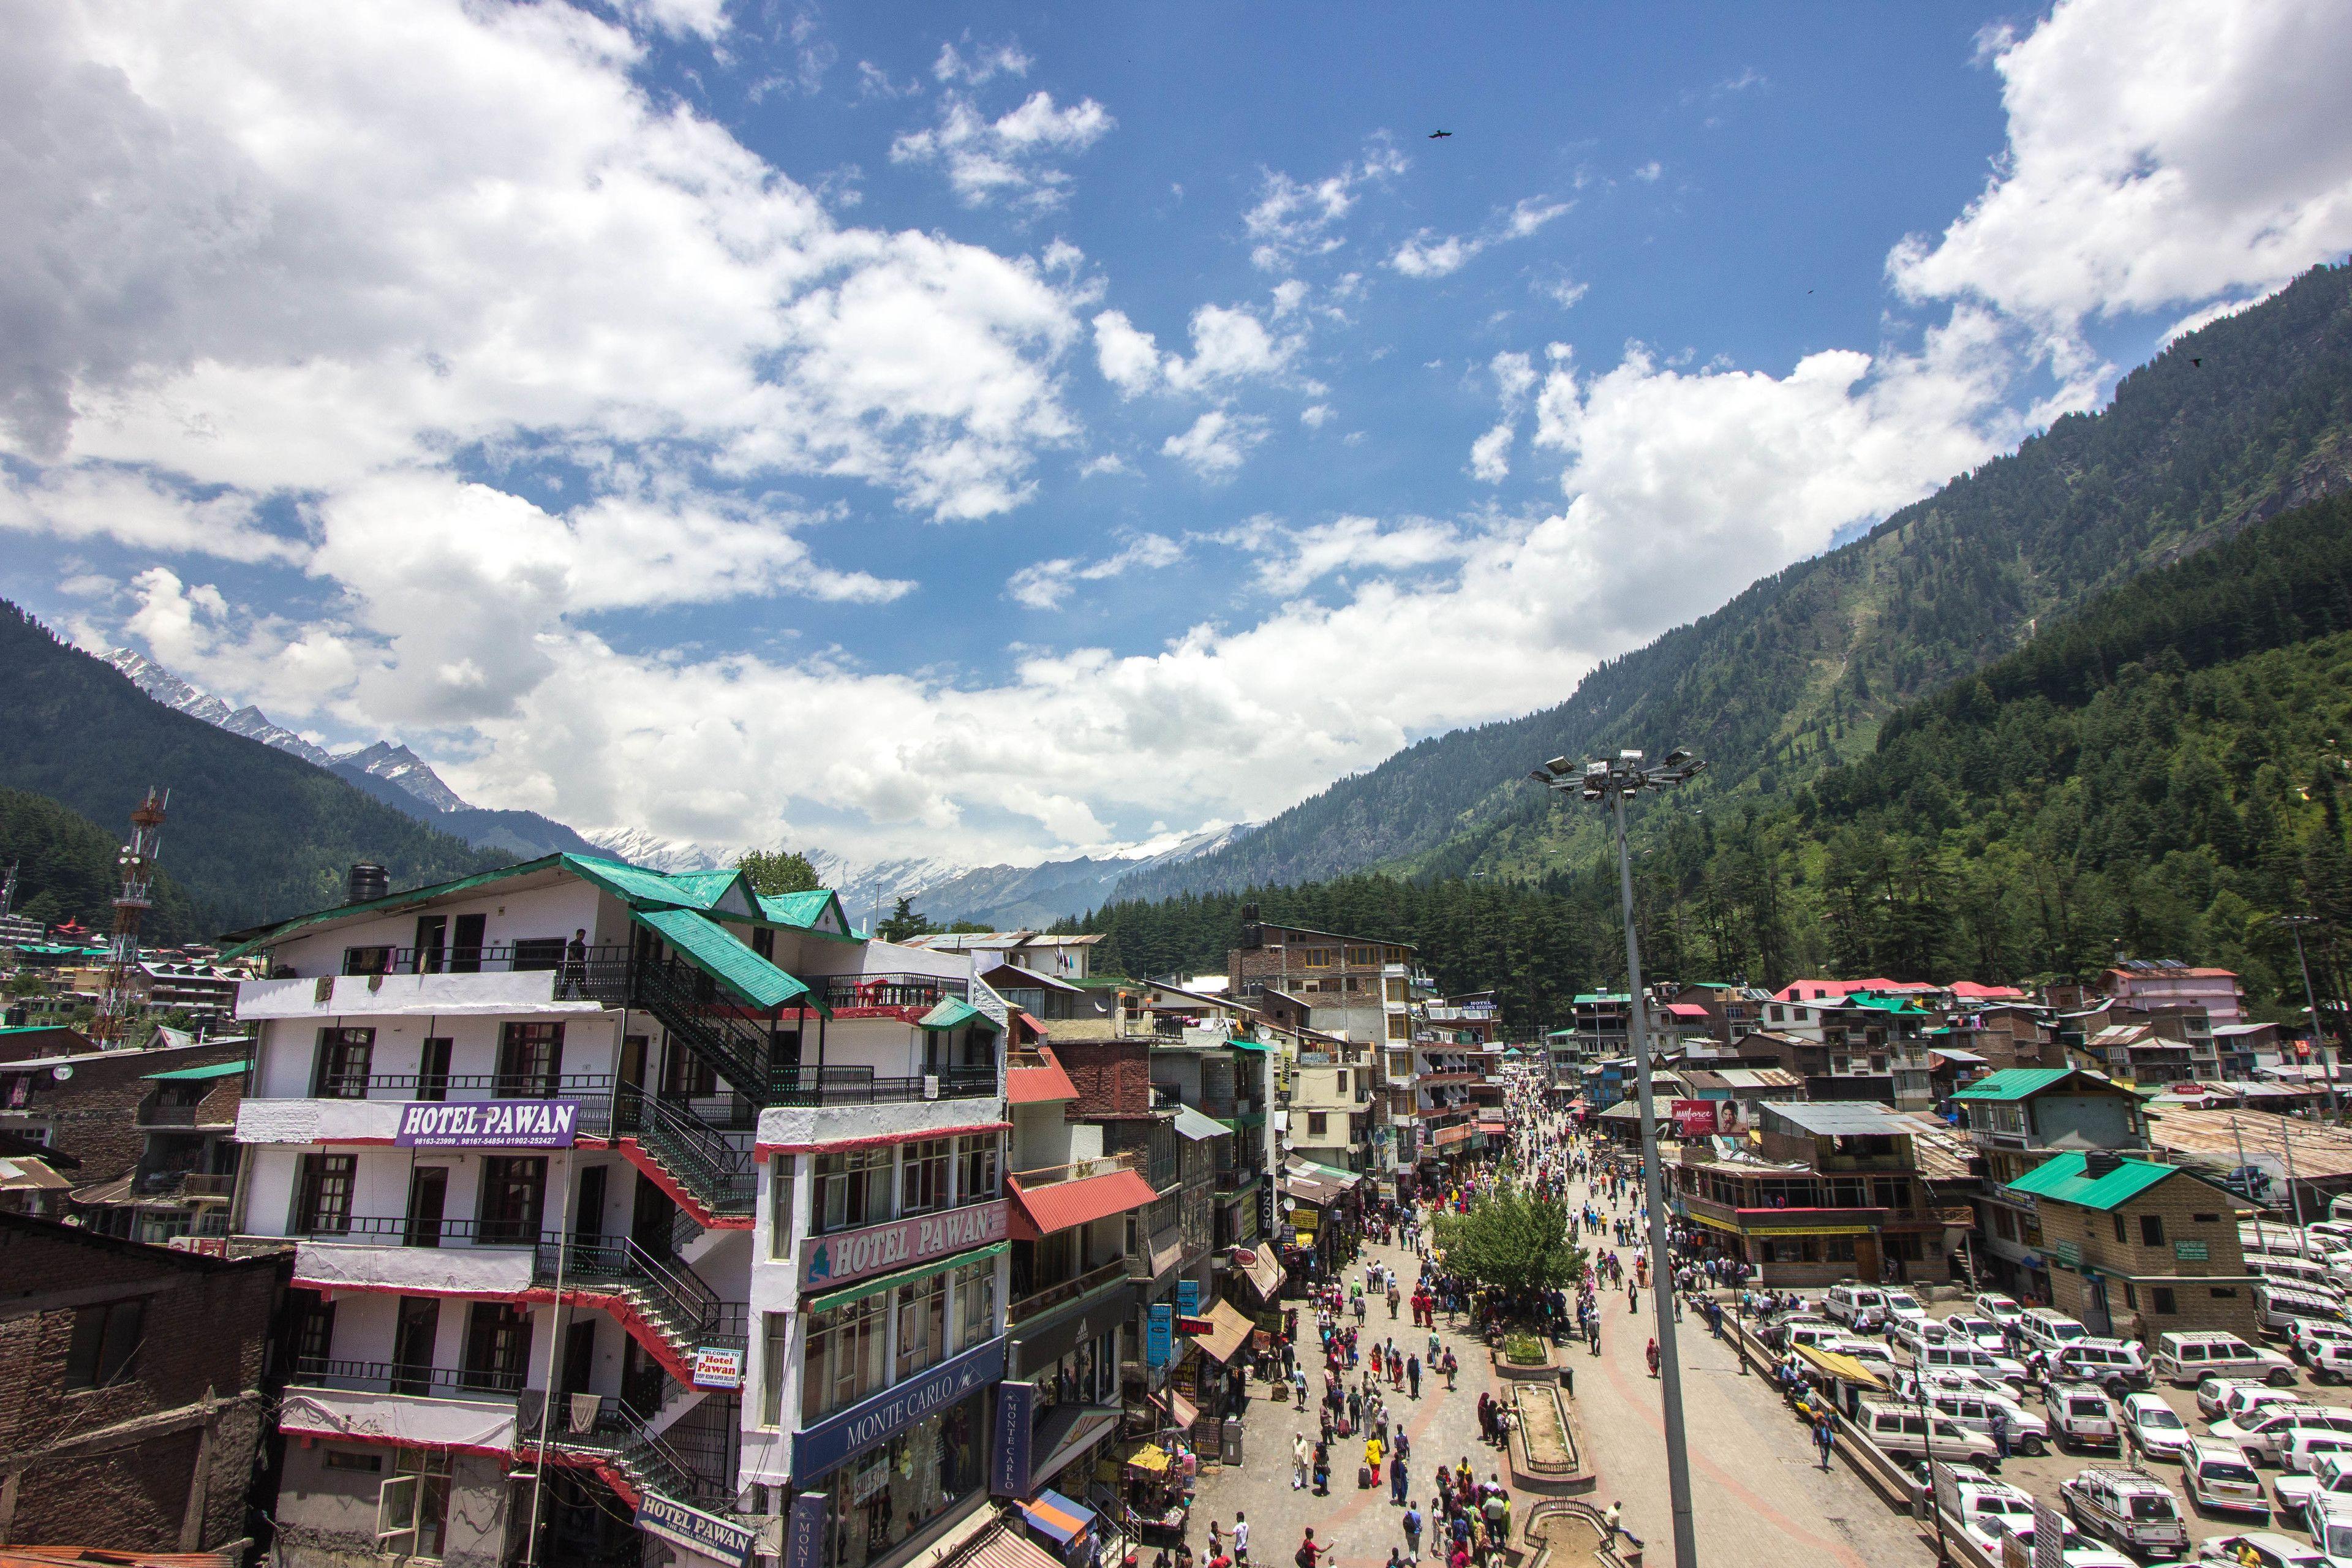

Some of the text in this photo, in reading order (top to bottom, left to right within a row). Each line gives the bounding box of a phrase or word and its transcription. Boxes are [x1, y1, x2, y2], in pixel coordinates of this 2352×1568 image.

[1282, 1057, 1291, 1085] Nikon
[404, 1105, 575, 1134] HOTEL PAWAN
[832, 1226, 910, 1278] HOTEL
[917, 1208, 989, 1255] PAWAN
[1237, 1250, 1253, 1259] HOTEL
[698, 1362, 736, 1374] Pawan
[705, 1355, 733, 1365] Hotel
[846, 1400, 903, 1450] MONTE
[908, 1376, 952, 1416] CARLO
[1007, 1403, 1016, 1445] MONTE
[1005, 1447, 1014, 1489] CARLO
[643, 1496, 749, 1553] HOTEL PAWAN
[2036, 1506, 2058, 1526] HOTELS
[649, 1523, 742, 1568] RECEPTION
[666, 1521, 718, 1548] THE MALL MANALI
